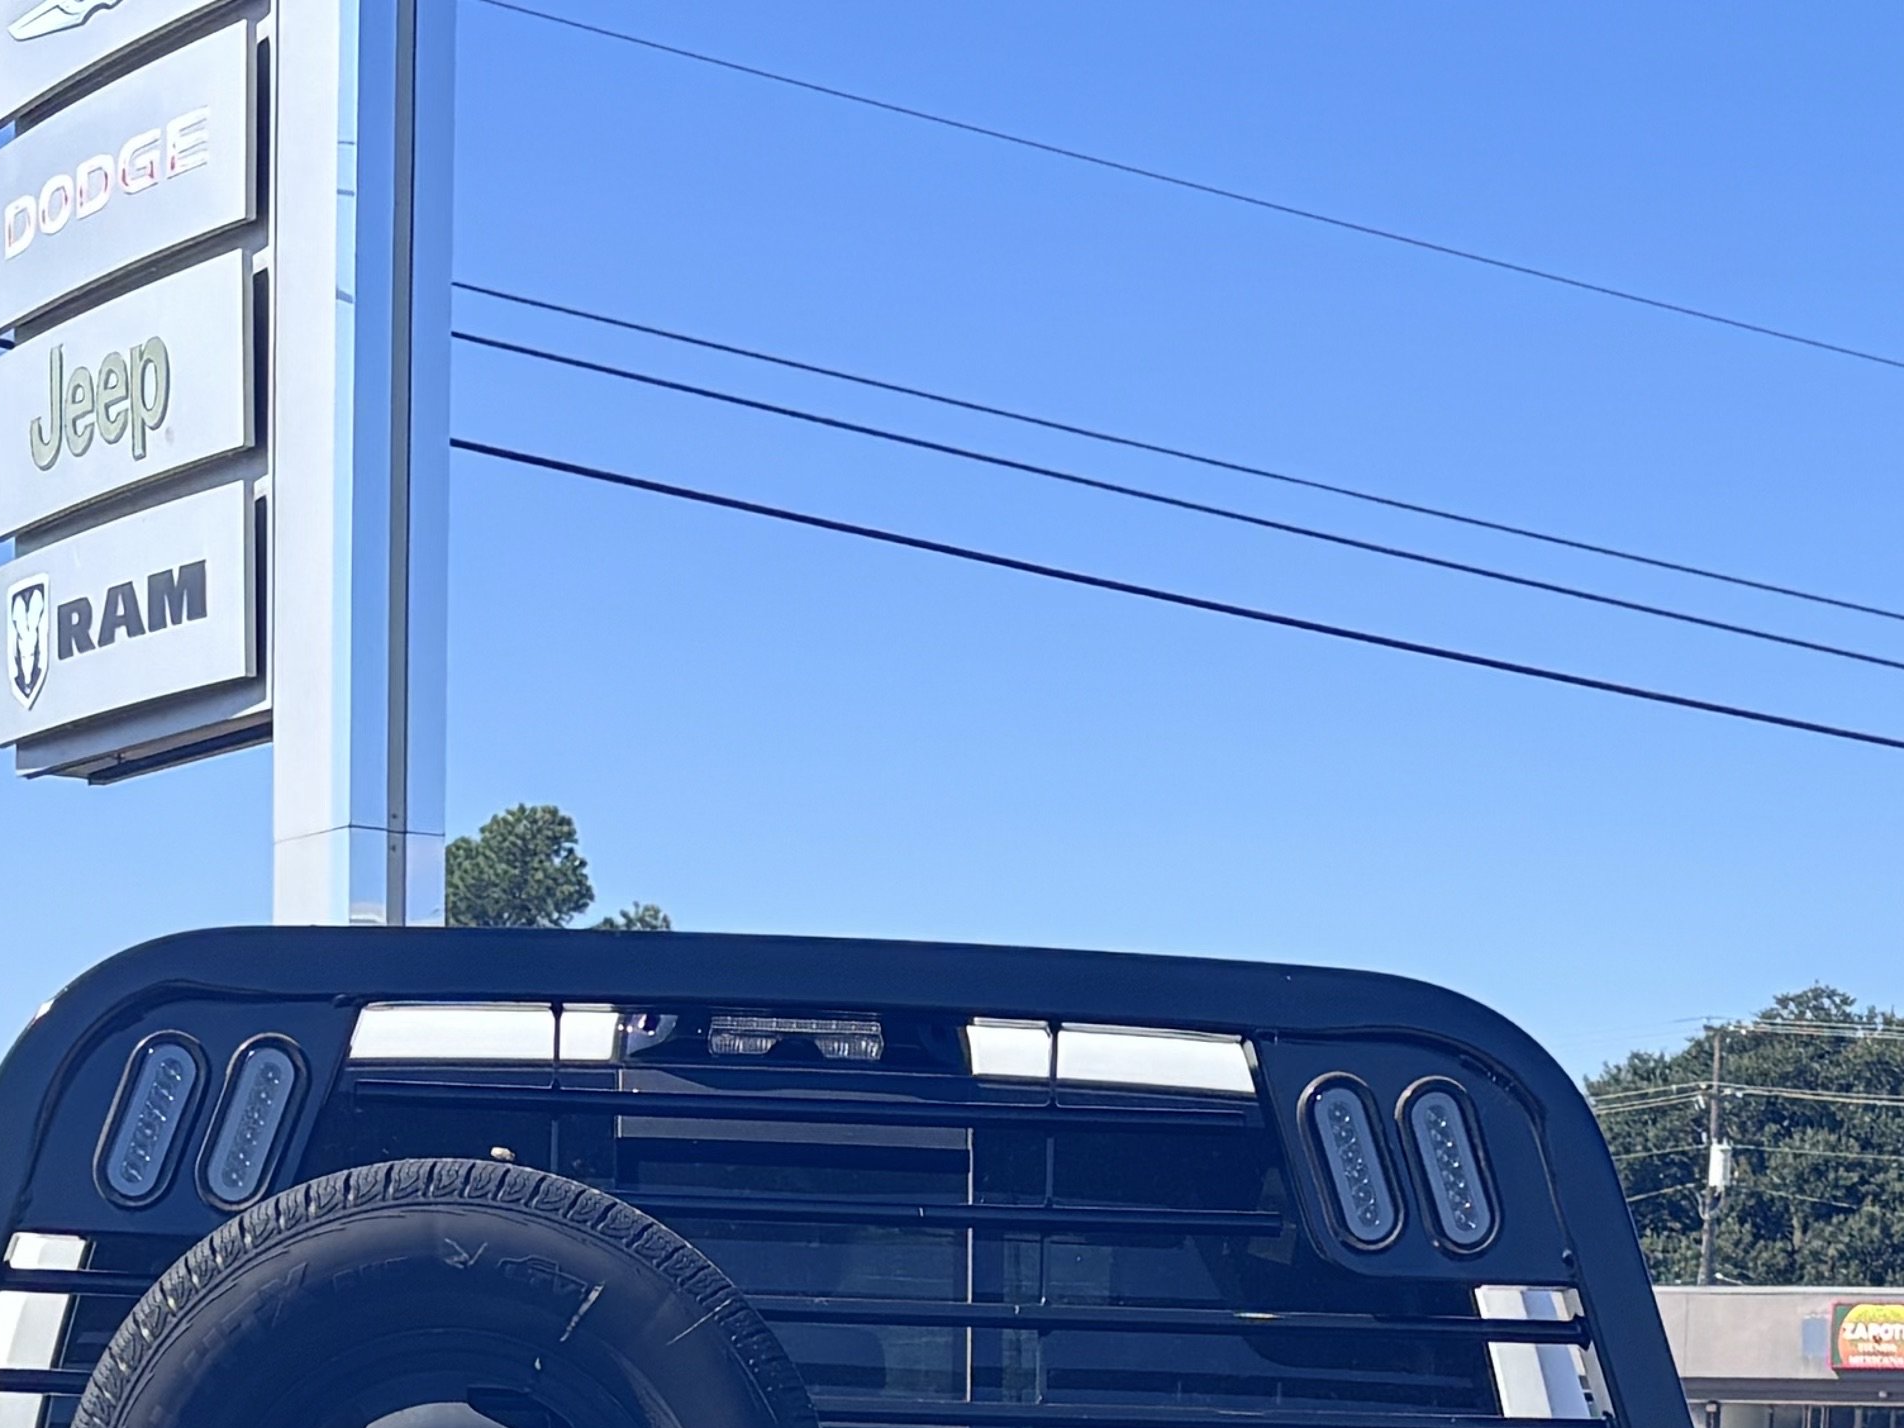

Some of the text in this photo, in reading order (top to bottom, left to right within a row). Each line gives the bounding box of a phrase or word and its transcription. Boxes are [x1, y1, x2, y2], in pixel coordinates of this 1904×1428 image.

[4, 106, 210, 259] DODGE
[30, 335, 170, 472] Jeep
[57, 558, 207, 661] RAM
